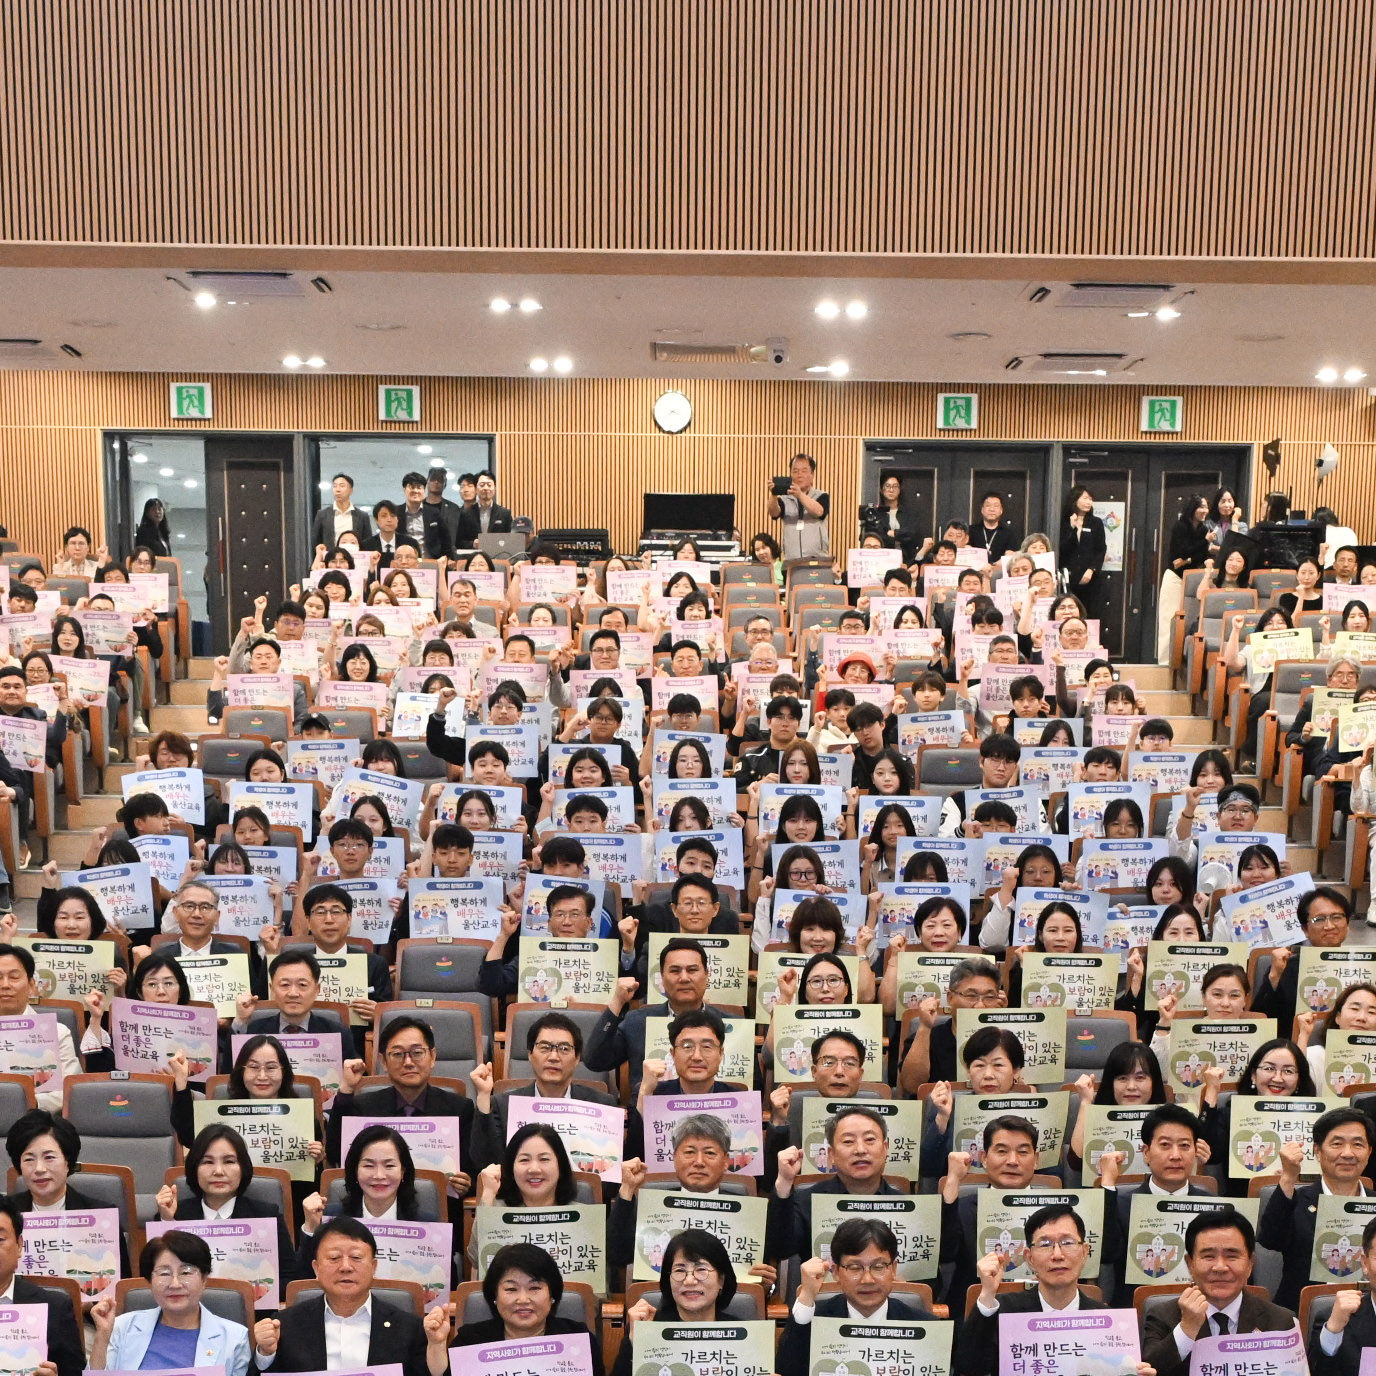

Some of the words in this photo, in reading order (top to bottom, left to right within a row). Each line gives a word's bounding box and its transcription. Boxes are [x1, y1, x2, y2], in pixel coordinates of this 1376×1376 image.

[1035, 1318, 1070, 1328] 지역사회가
[1070, 1317, 1105, 1327] 함께합니다
[672, 1329, 701, 1338] 교직원이
[701, 1329, 736, 1338] 함께합니다
[680, 1349, 737, 1365] 가르치는
[1009, 1342, 1038, 1359] 함께
[1043, 1341, 1086, 1358] 만드는
[1012, 1359, 1025, 1373] 더
[1029, 1358, 1059, 1375] 좋은
